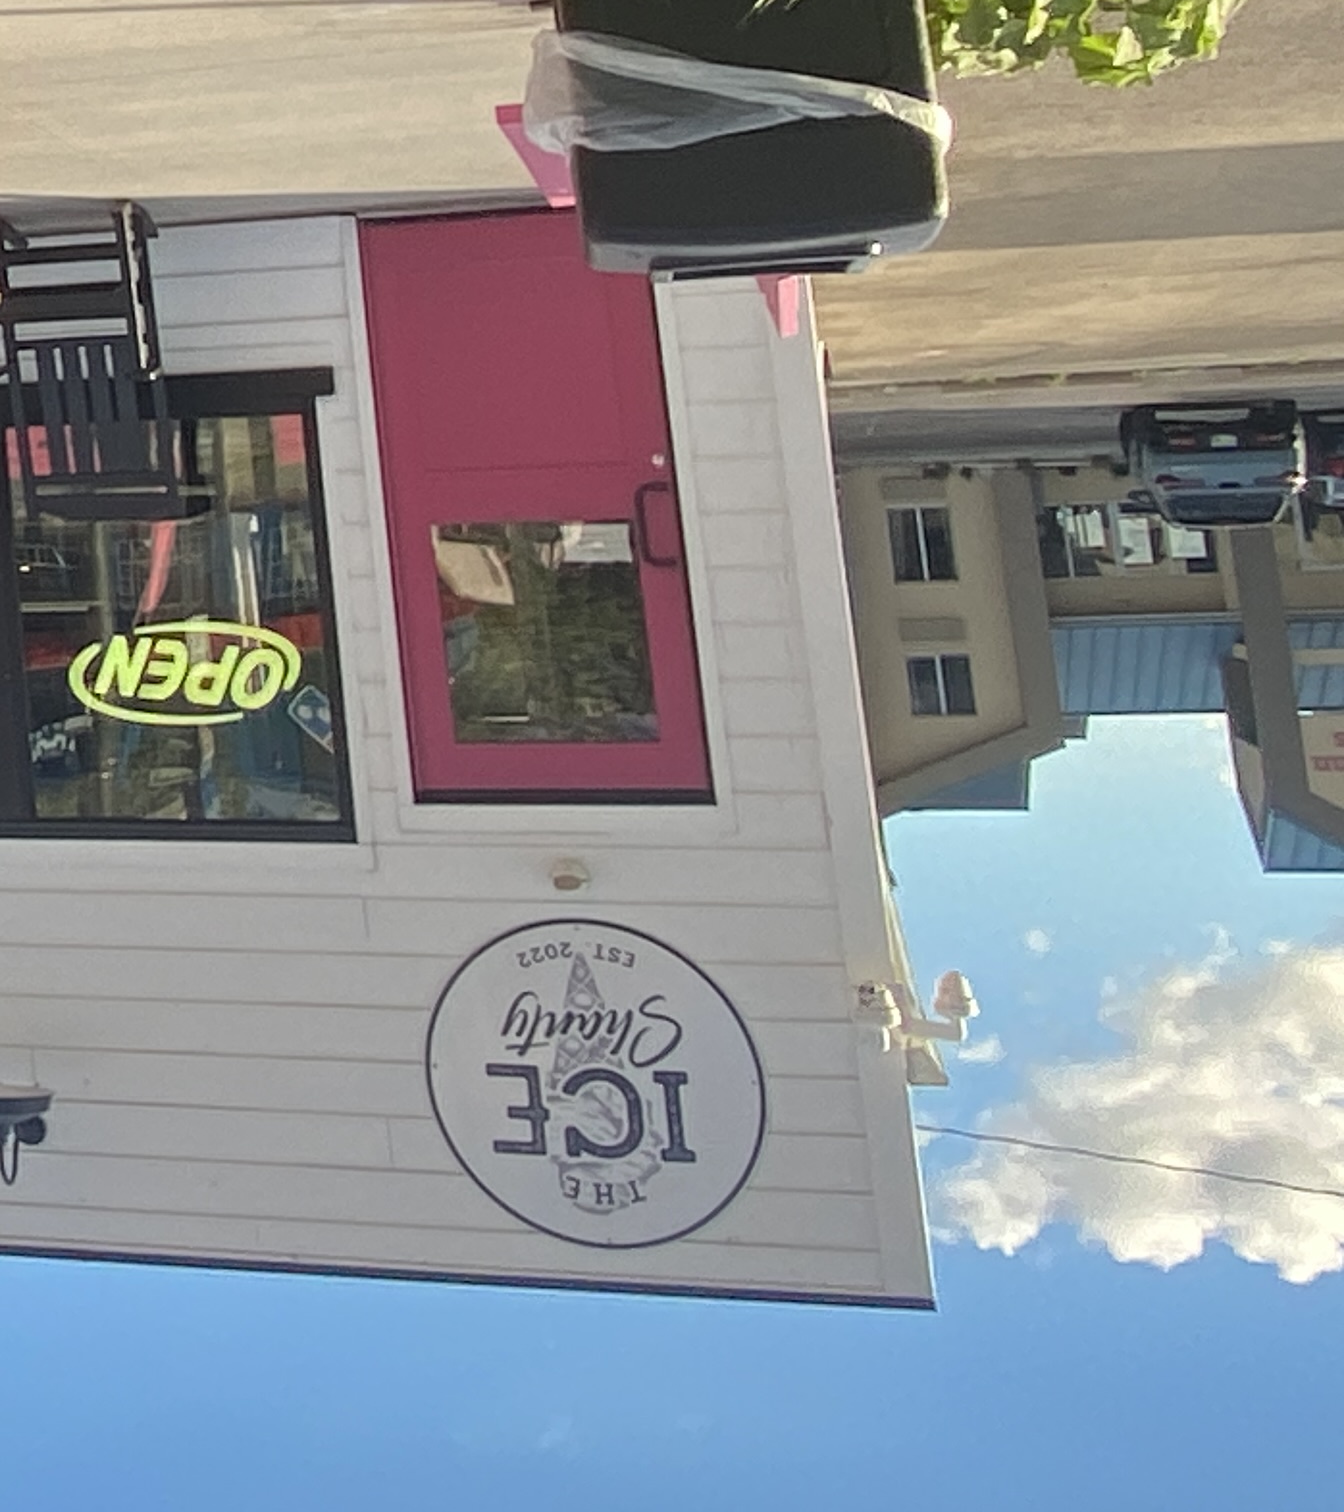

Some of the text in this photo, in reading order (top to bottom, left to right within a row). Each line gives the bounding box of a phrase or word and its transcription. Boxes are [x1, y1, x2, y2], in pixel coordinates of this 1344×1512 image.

[94, 635, 284, 709] OPEN
[516, 942, 572, 968] 2022
[501, 991, 682, 1067] Shanty
[486, 1064, 697, 1163] ICE
[563, 1176, 646, 1205] THE
